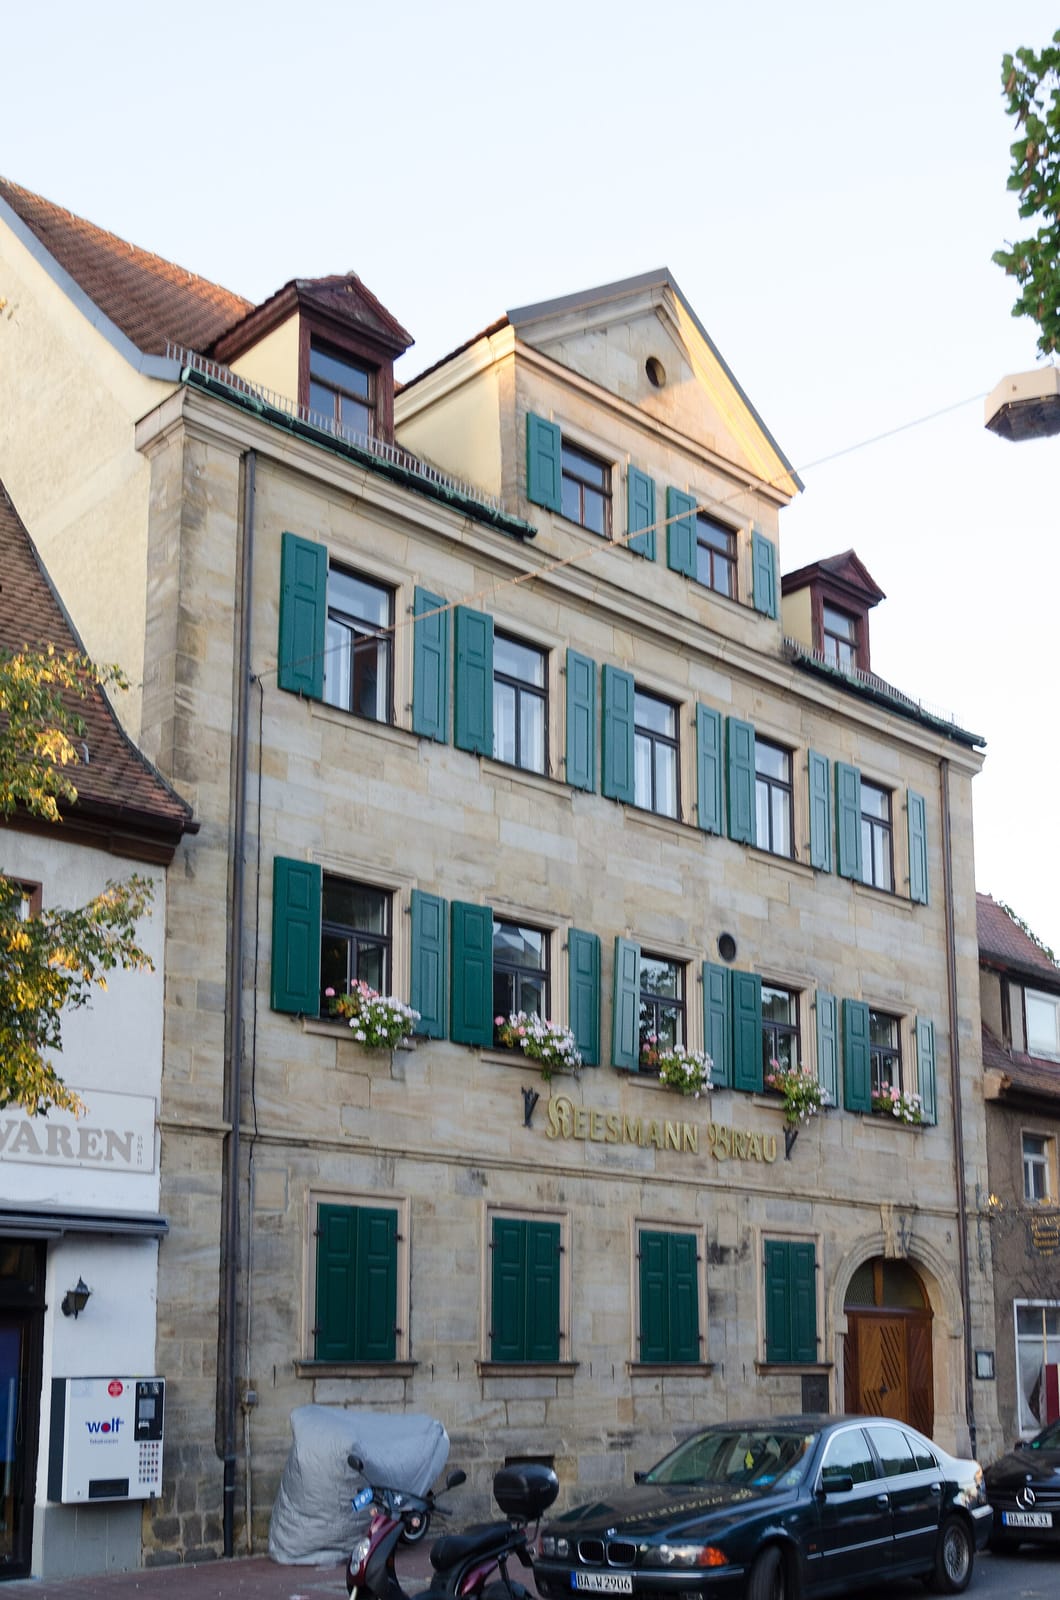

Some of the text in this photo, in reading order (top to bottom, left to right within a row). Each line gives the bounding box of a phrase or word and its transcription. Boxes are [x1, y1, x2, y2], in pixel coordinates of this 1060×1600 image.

[545, 1094, 699, 1153] KEESMANN
[87, 1417, 120, 1434] wolf
[604, 1575, 631, 1590] 2906
